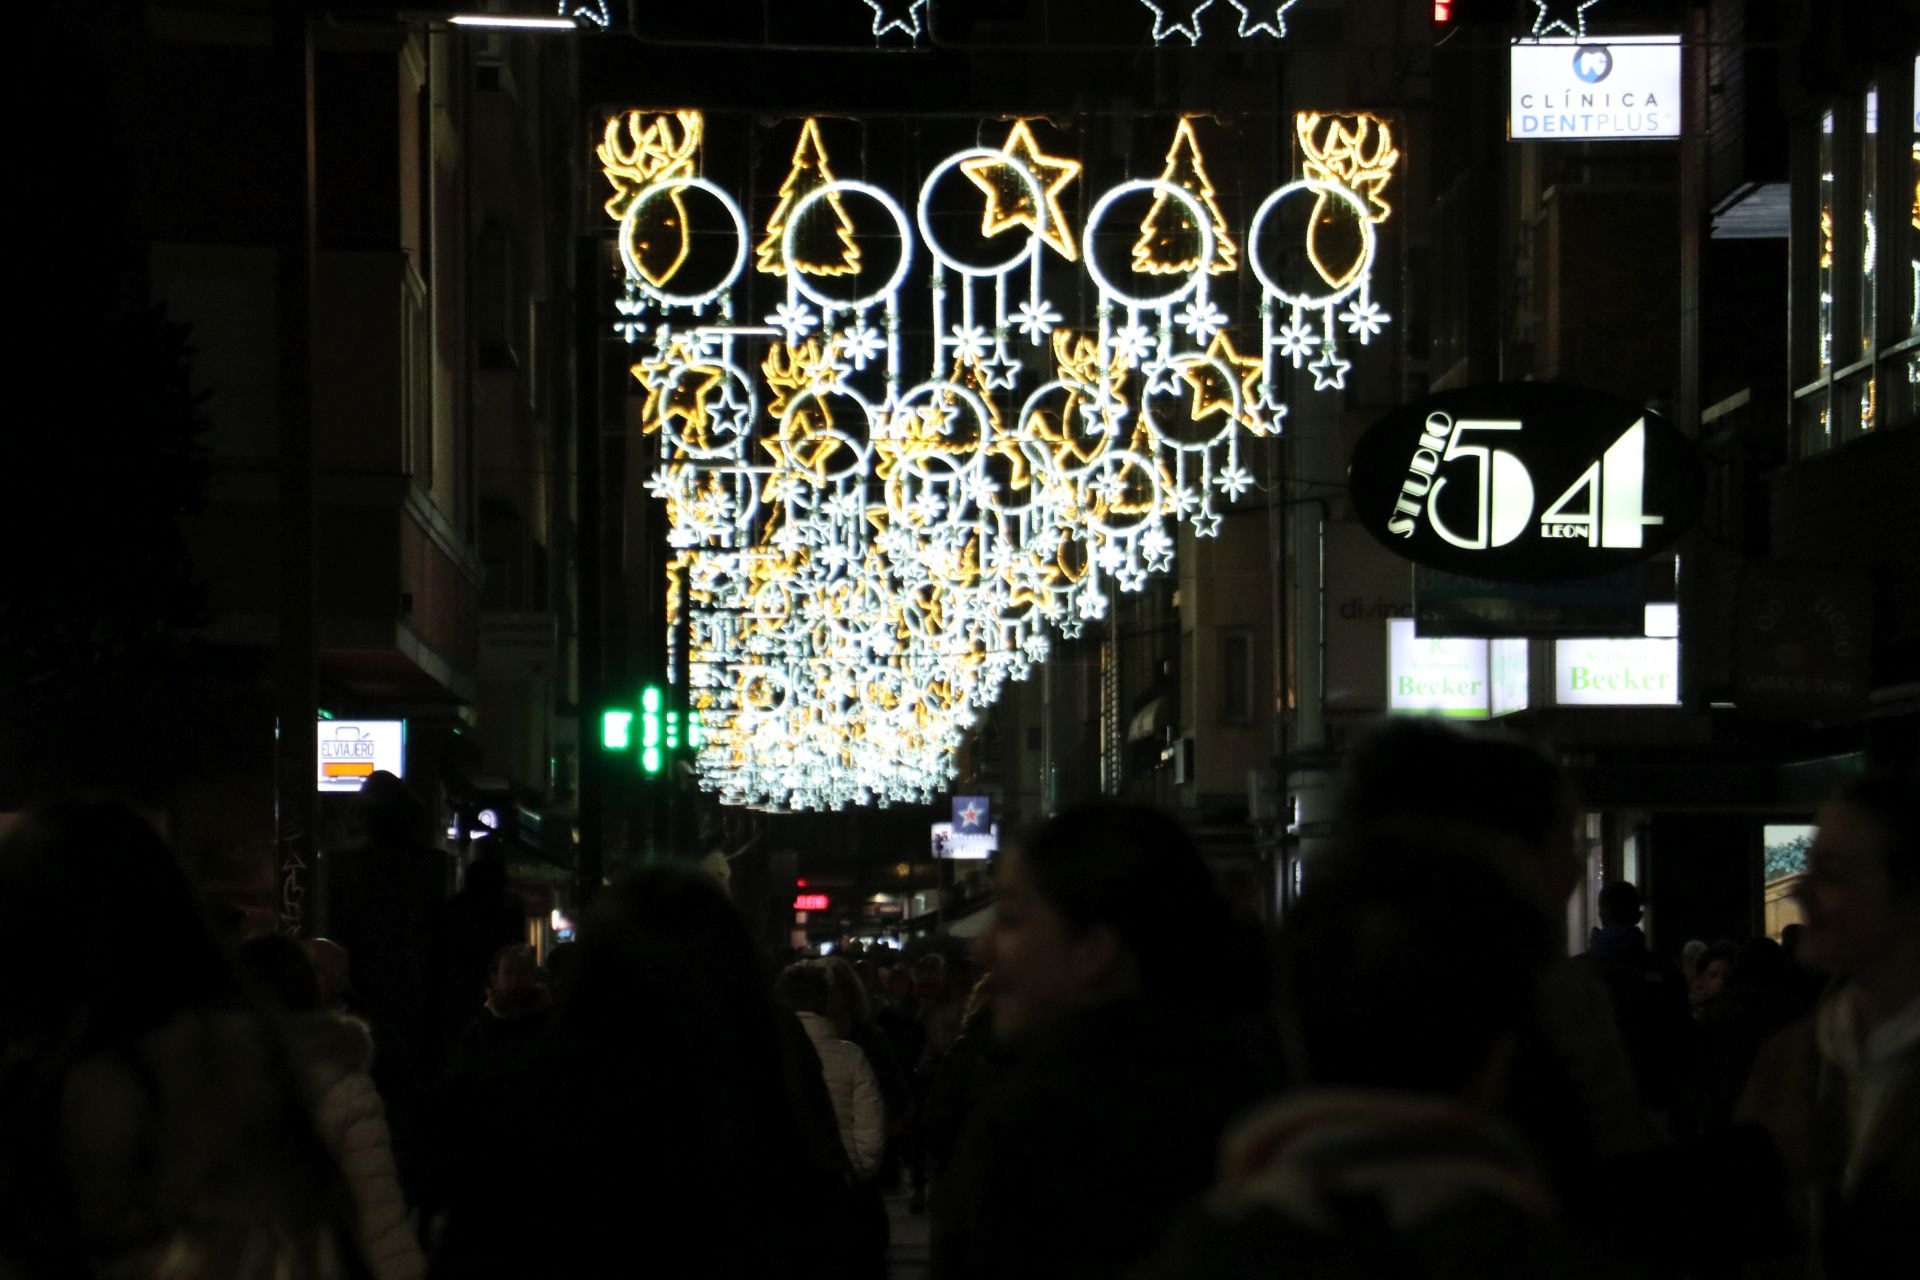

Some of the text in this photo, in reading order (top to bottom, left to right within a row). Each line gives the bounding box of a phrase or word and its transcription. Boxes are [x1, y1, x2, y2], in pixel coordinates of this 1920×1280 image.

[1520, 89, 1658, 109] CLÍNICA
[1521, 112, 1659, 133] DENTPLUS
[1388, 410, 1664, 550] STUDIO 54
[1541, 524, 1589, 538] LEON
[1397, 674, 1483, 697] Becker
[1569, 664, 1671, 692] Becker
[322, 743, 374, 756] EL VIAJERO
